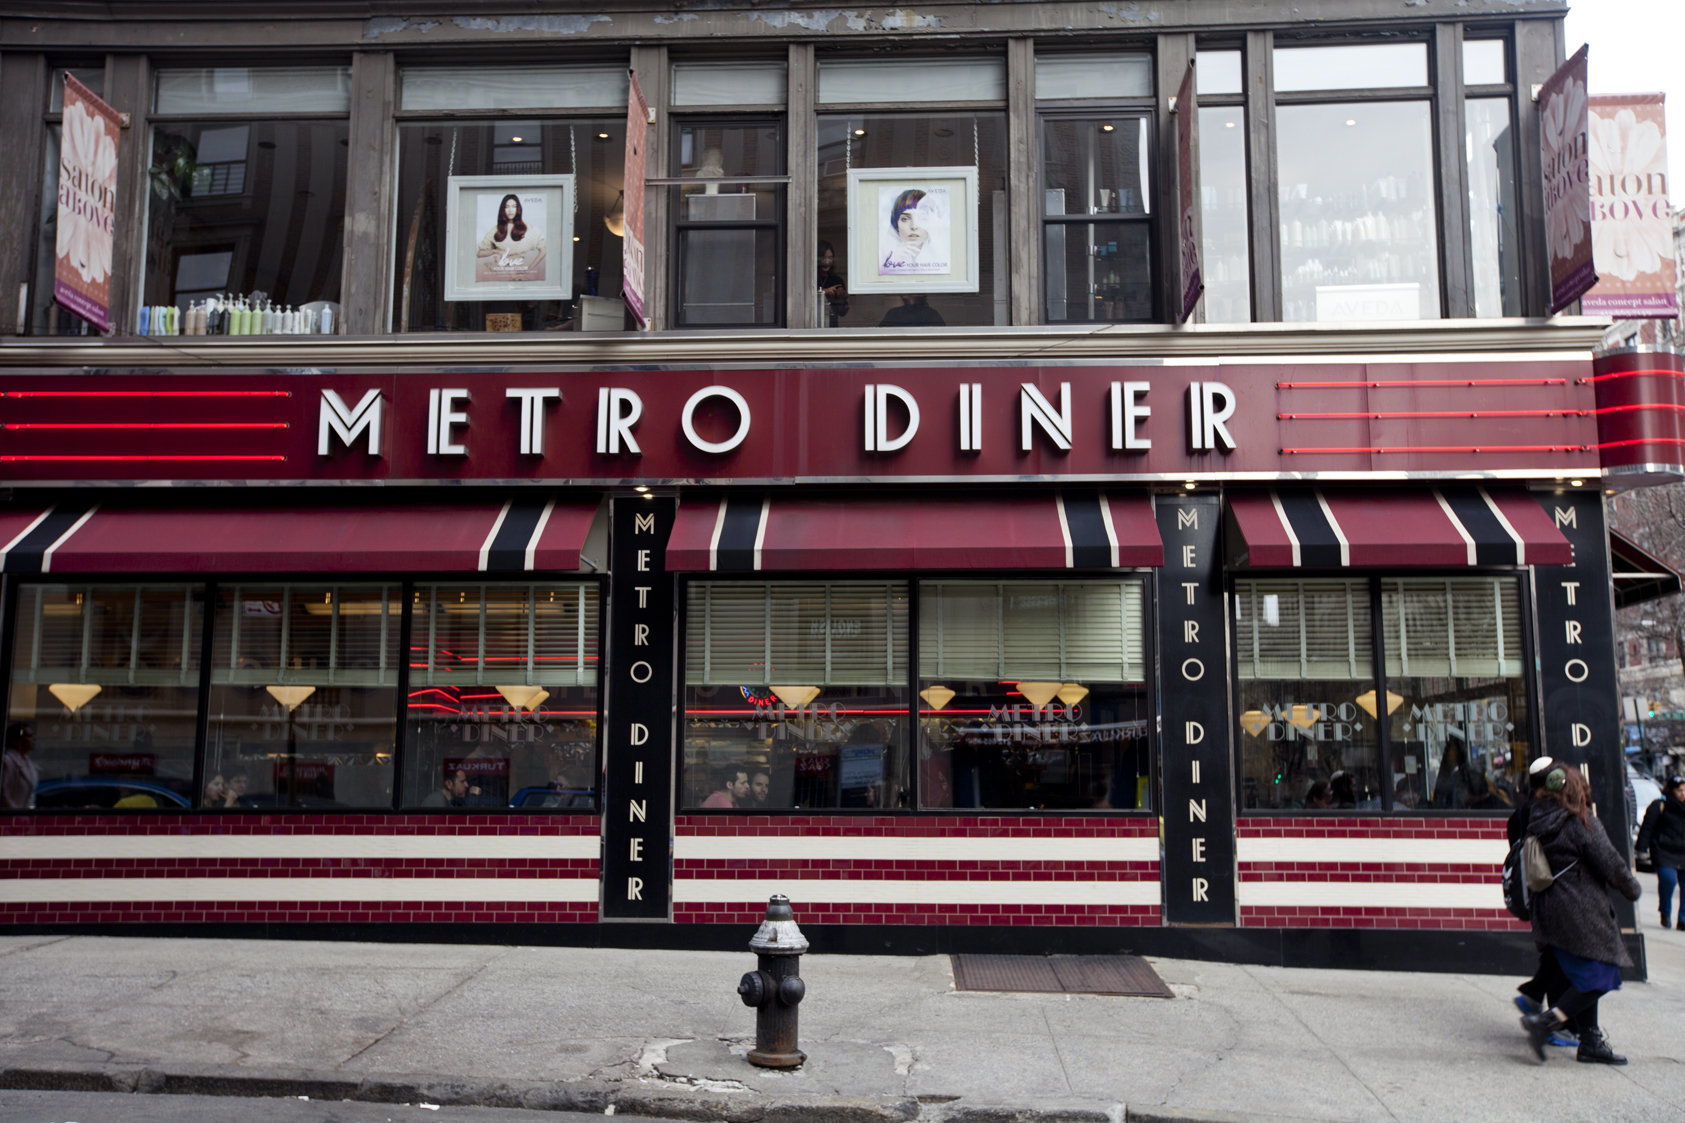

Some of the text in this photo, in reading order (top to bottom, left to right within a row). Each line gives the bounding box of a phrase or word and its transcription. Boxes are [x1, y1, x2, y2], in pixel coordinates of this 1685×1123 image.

[1608, 298, 1642, 308] concept
[1644, 297, 1667, 305] salon
[318, 380, 1240, 458] METRO DINER
[627, 513, 655, 901] METRO DINER
[988, 703, 1082, 721] METRO
[1177, 505, 1209, 902] METRO DINER
[1261, 702, 1357, 721] METRO
[1408, 702, 1508, 721] METRO
[995, 723, 1078, 742] DINER
[1267, 722, 1352, 741] DINER
